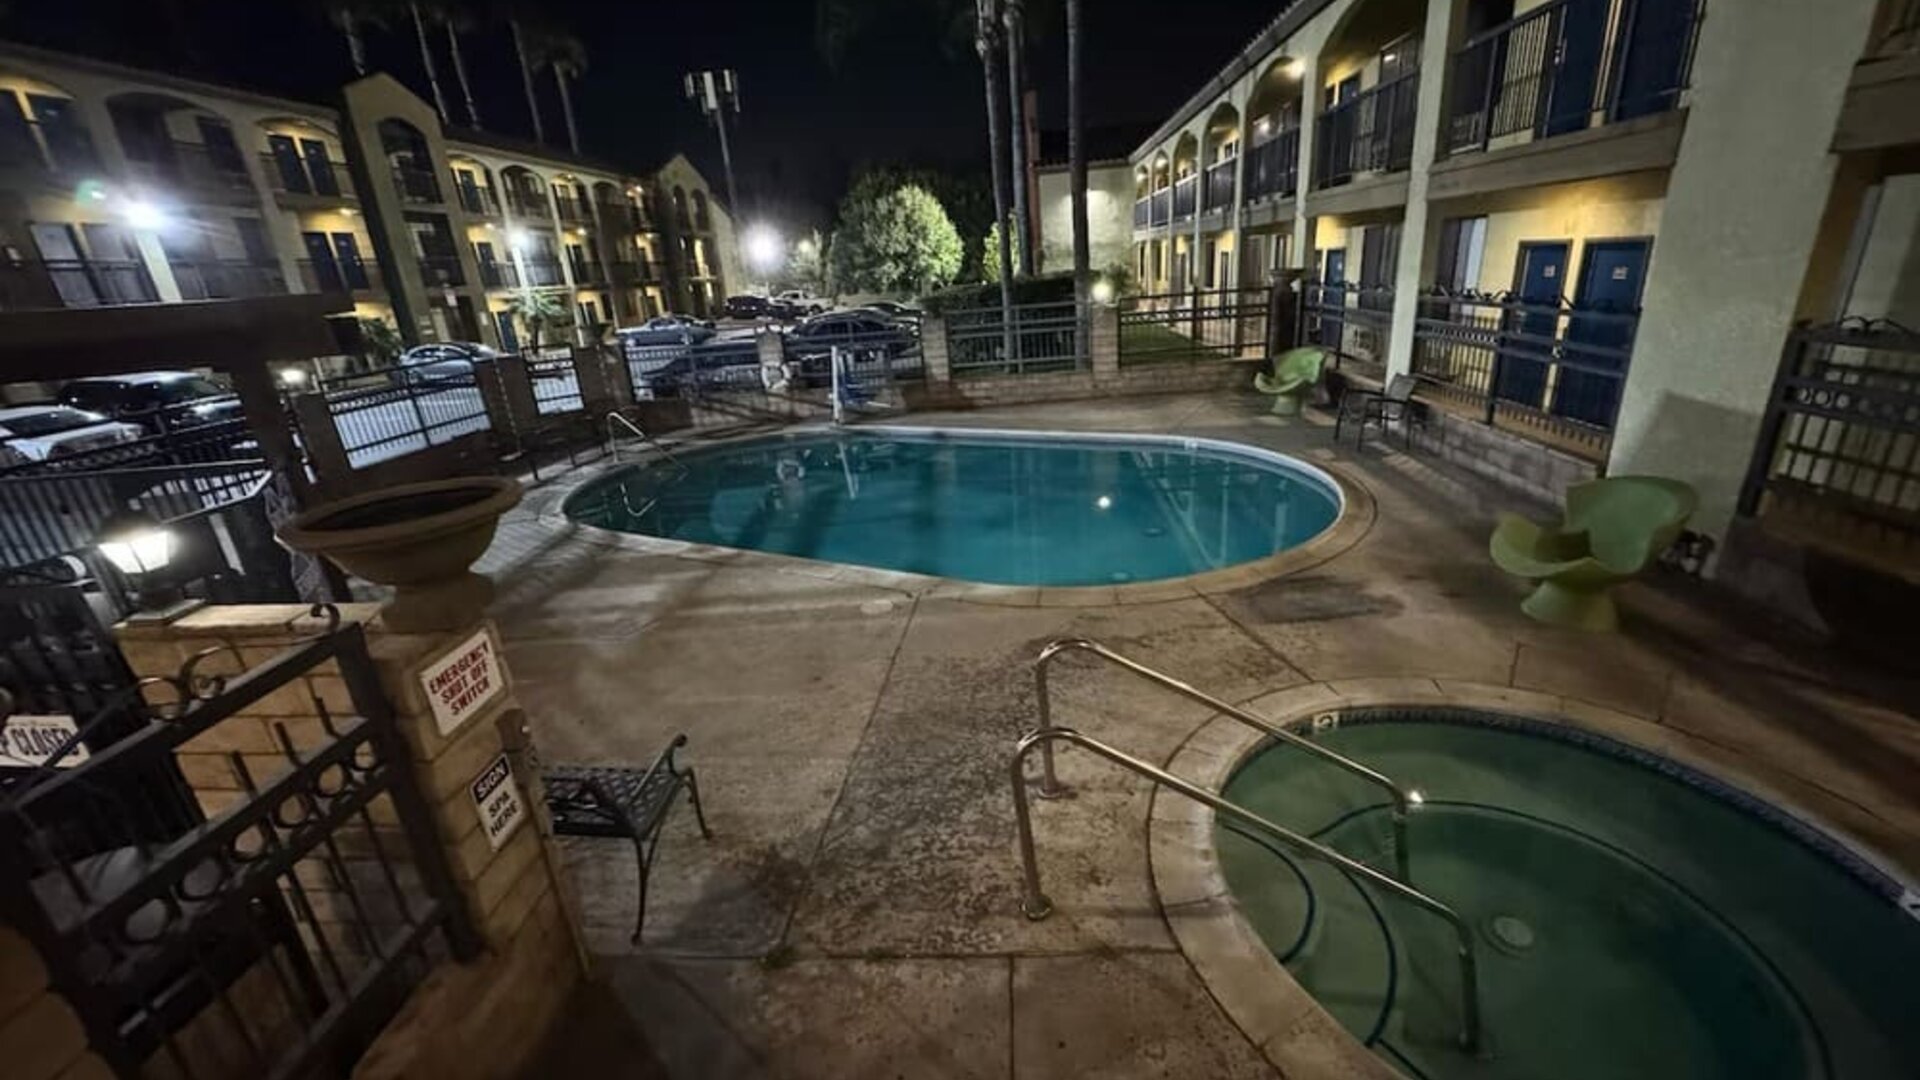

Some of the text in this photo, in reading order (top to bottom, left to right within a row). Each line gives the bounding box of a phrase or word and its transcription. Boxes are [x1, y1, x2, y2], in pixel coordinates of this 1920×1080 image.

[429, 641, 489, 694] EMERGENCY
[441, 659, 489, 704] SHUT OFF
[450, 676, 490, 715] SWITCH
[476, 761, 506, 799] SIGN
[489, 791, 510, 818] SPA
[490, 801, 518, 837] HERE
